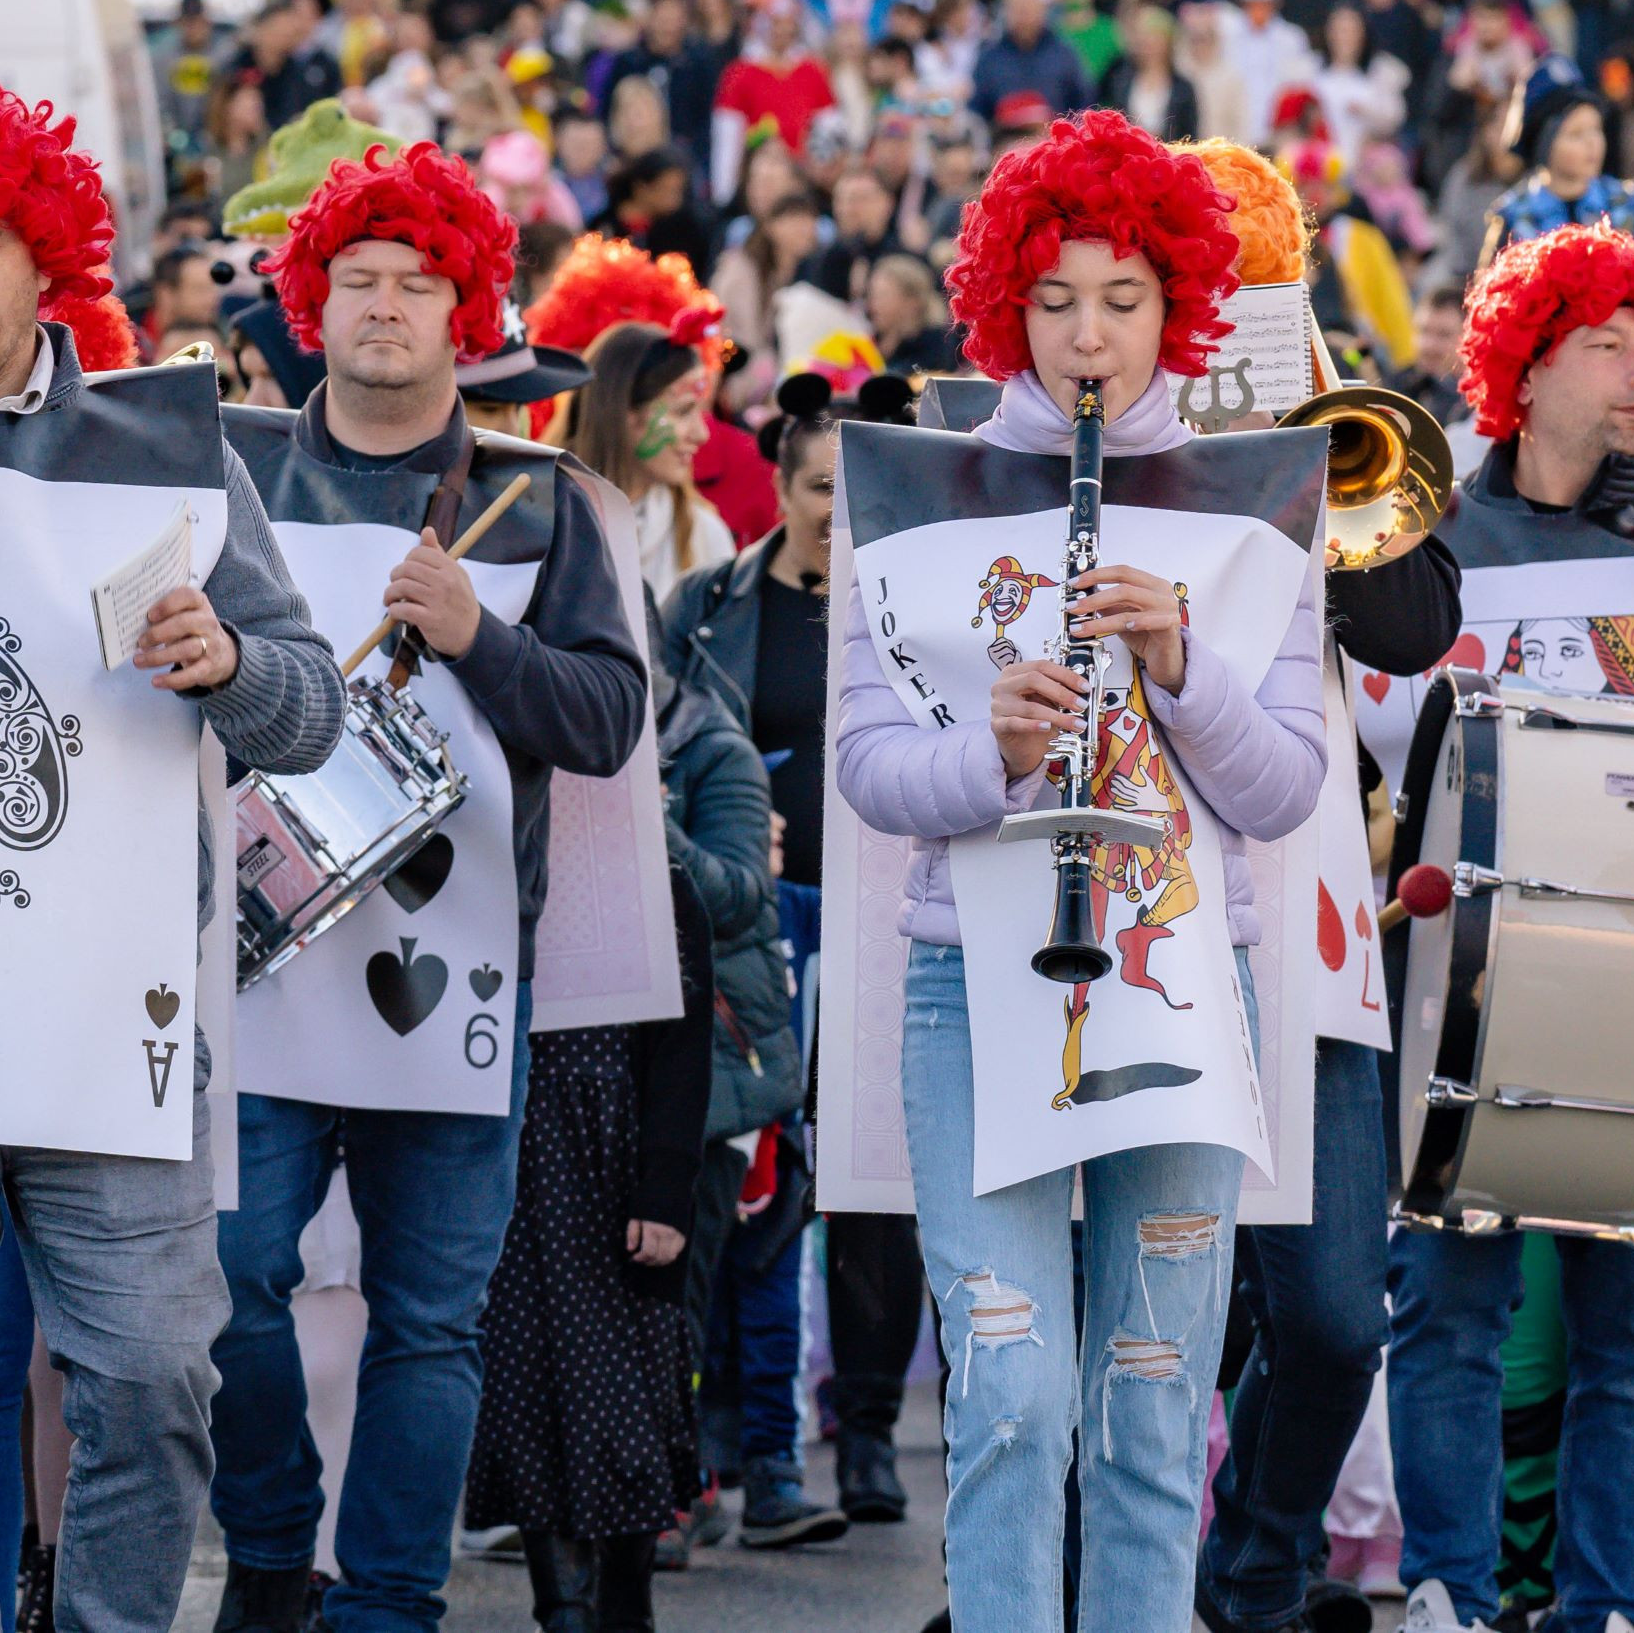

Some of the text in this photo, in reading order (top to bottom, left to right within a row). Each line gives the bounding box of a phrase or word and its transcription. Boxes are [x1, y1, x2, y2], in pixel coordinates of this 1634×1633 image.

[877, 577, 958, 730] JOKER
[247, 852, 270, 877] STEEL
[1361, 949, 1381, 1012] 7
[141, 1039, 179, 1108] A
